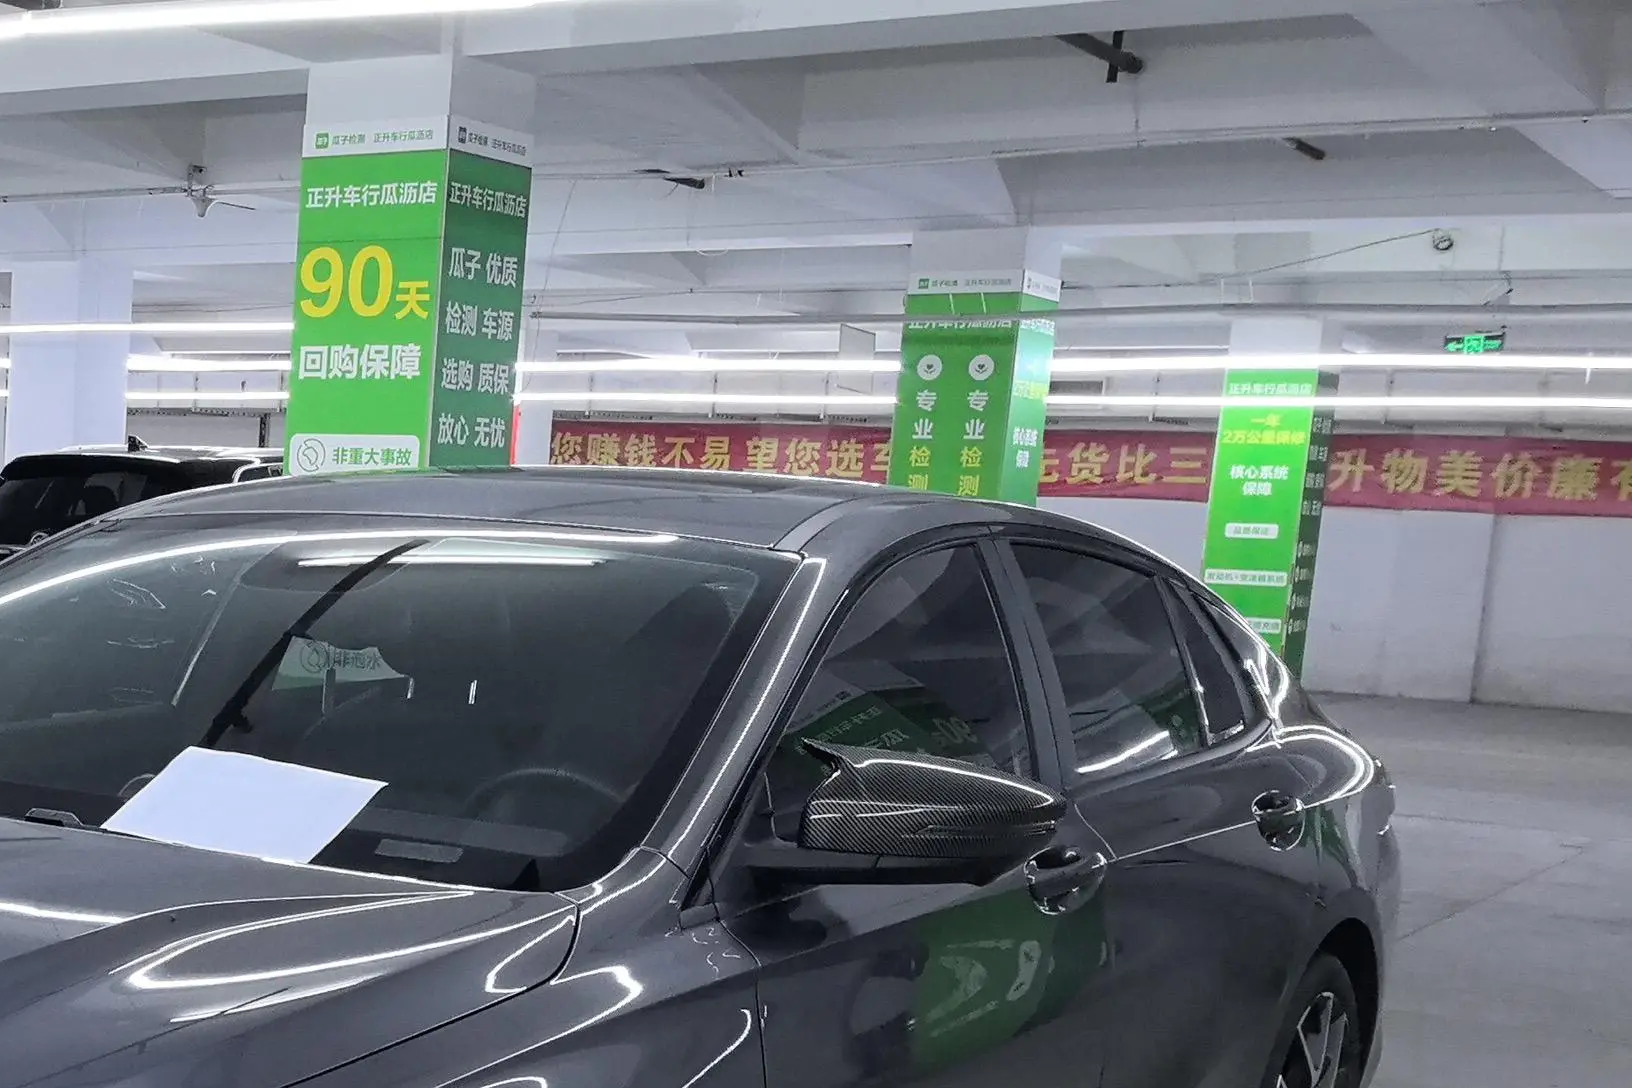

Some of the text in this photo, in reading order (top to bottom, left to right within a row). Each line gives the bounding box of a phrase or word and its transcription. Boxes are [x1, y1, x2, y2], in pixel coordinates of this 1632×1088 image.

[305, 181, 438, 208] 正升车行瓜沥店
[450, 181, 527, 218] 正升车行瓜沥店
[300, 244, 431, 320] 90天
[449, 247, 518, 289] 瓜子 优质
[445, 301, 515, 341] 检测 车源
[298, 343, 421, 380] 回购保障
[441, 357, 510, 395] 选购 质保
[437, 413, 506, 448] 放心 无忧
[958, 389, 989, 497] 专业检测
[332, 447, 412, 467] 非重大事故
[551, 433, 730, 471] 您赚钱不易
